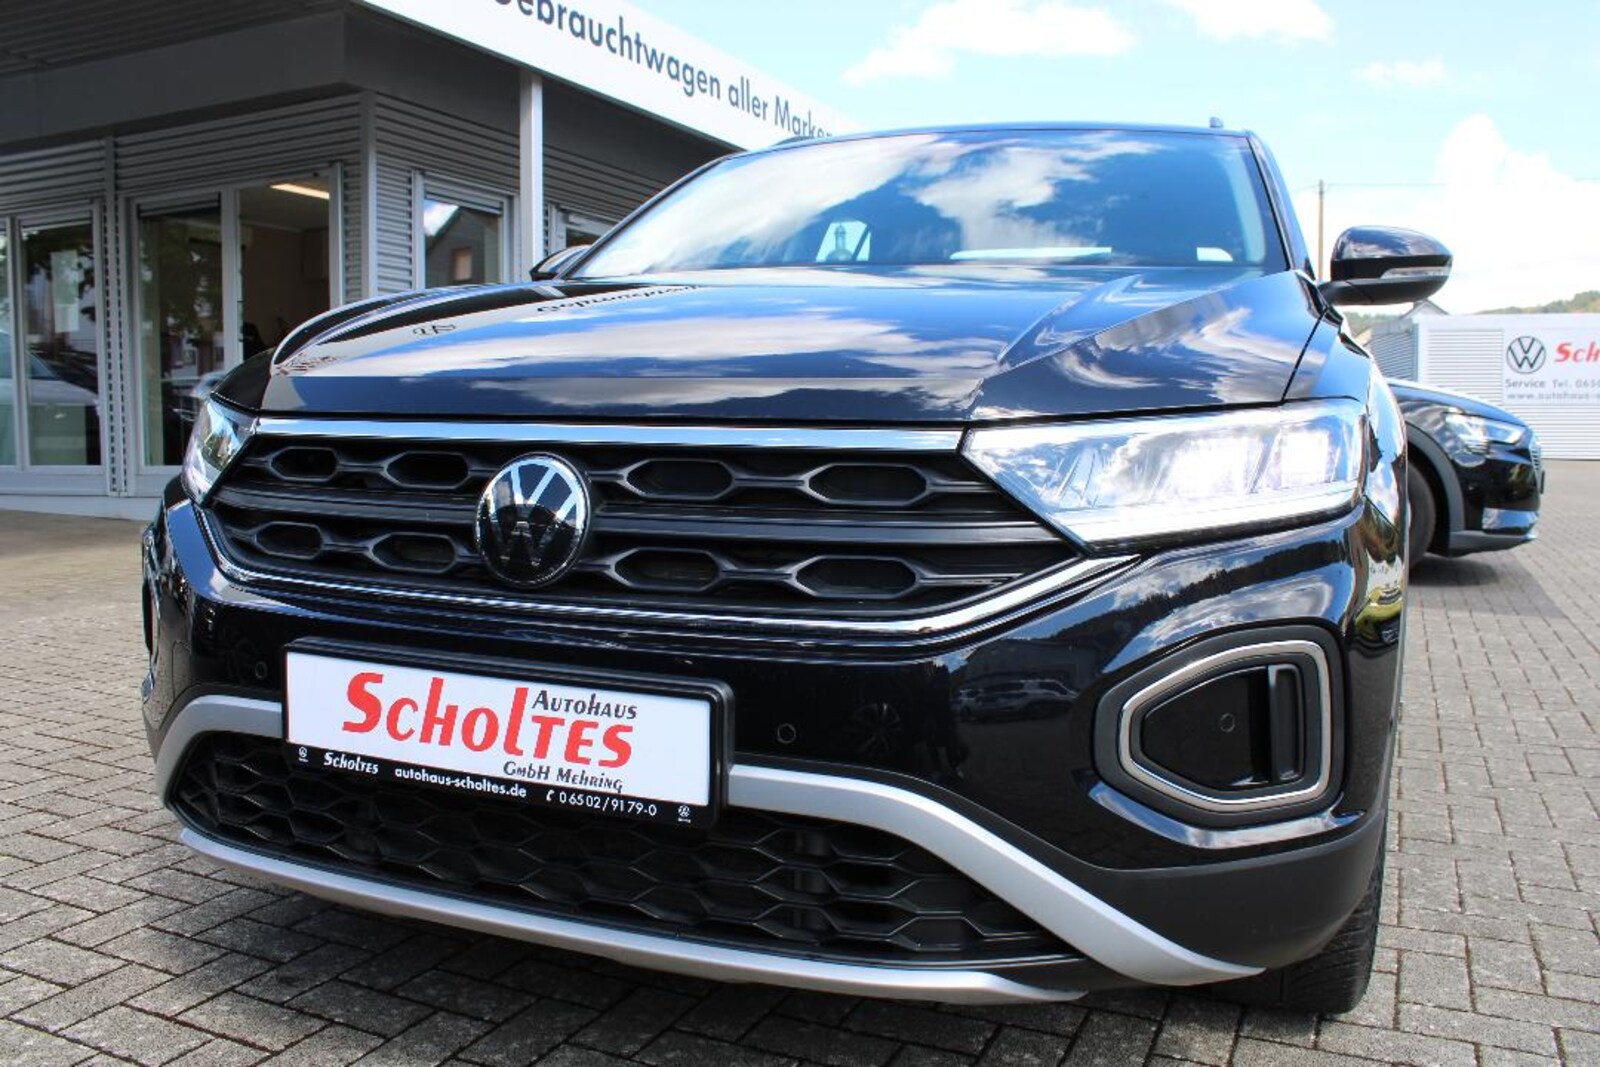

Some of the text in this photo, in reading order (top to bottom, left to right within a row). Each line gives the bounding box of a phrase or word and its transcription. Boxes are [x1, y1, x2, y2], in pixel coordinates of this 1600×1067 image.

[494, 0, 833, 138] ebrauchtwagen aller Mark
[1507, 336, 1546, 371] VW
[1505, 379, 1545, 389] Service
[479, 455, 586, 580] VW
[394, 768, 527, 798] autohaus-scholtes.de
